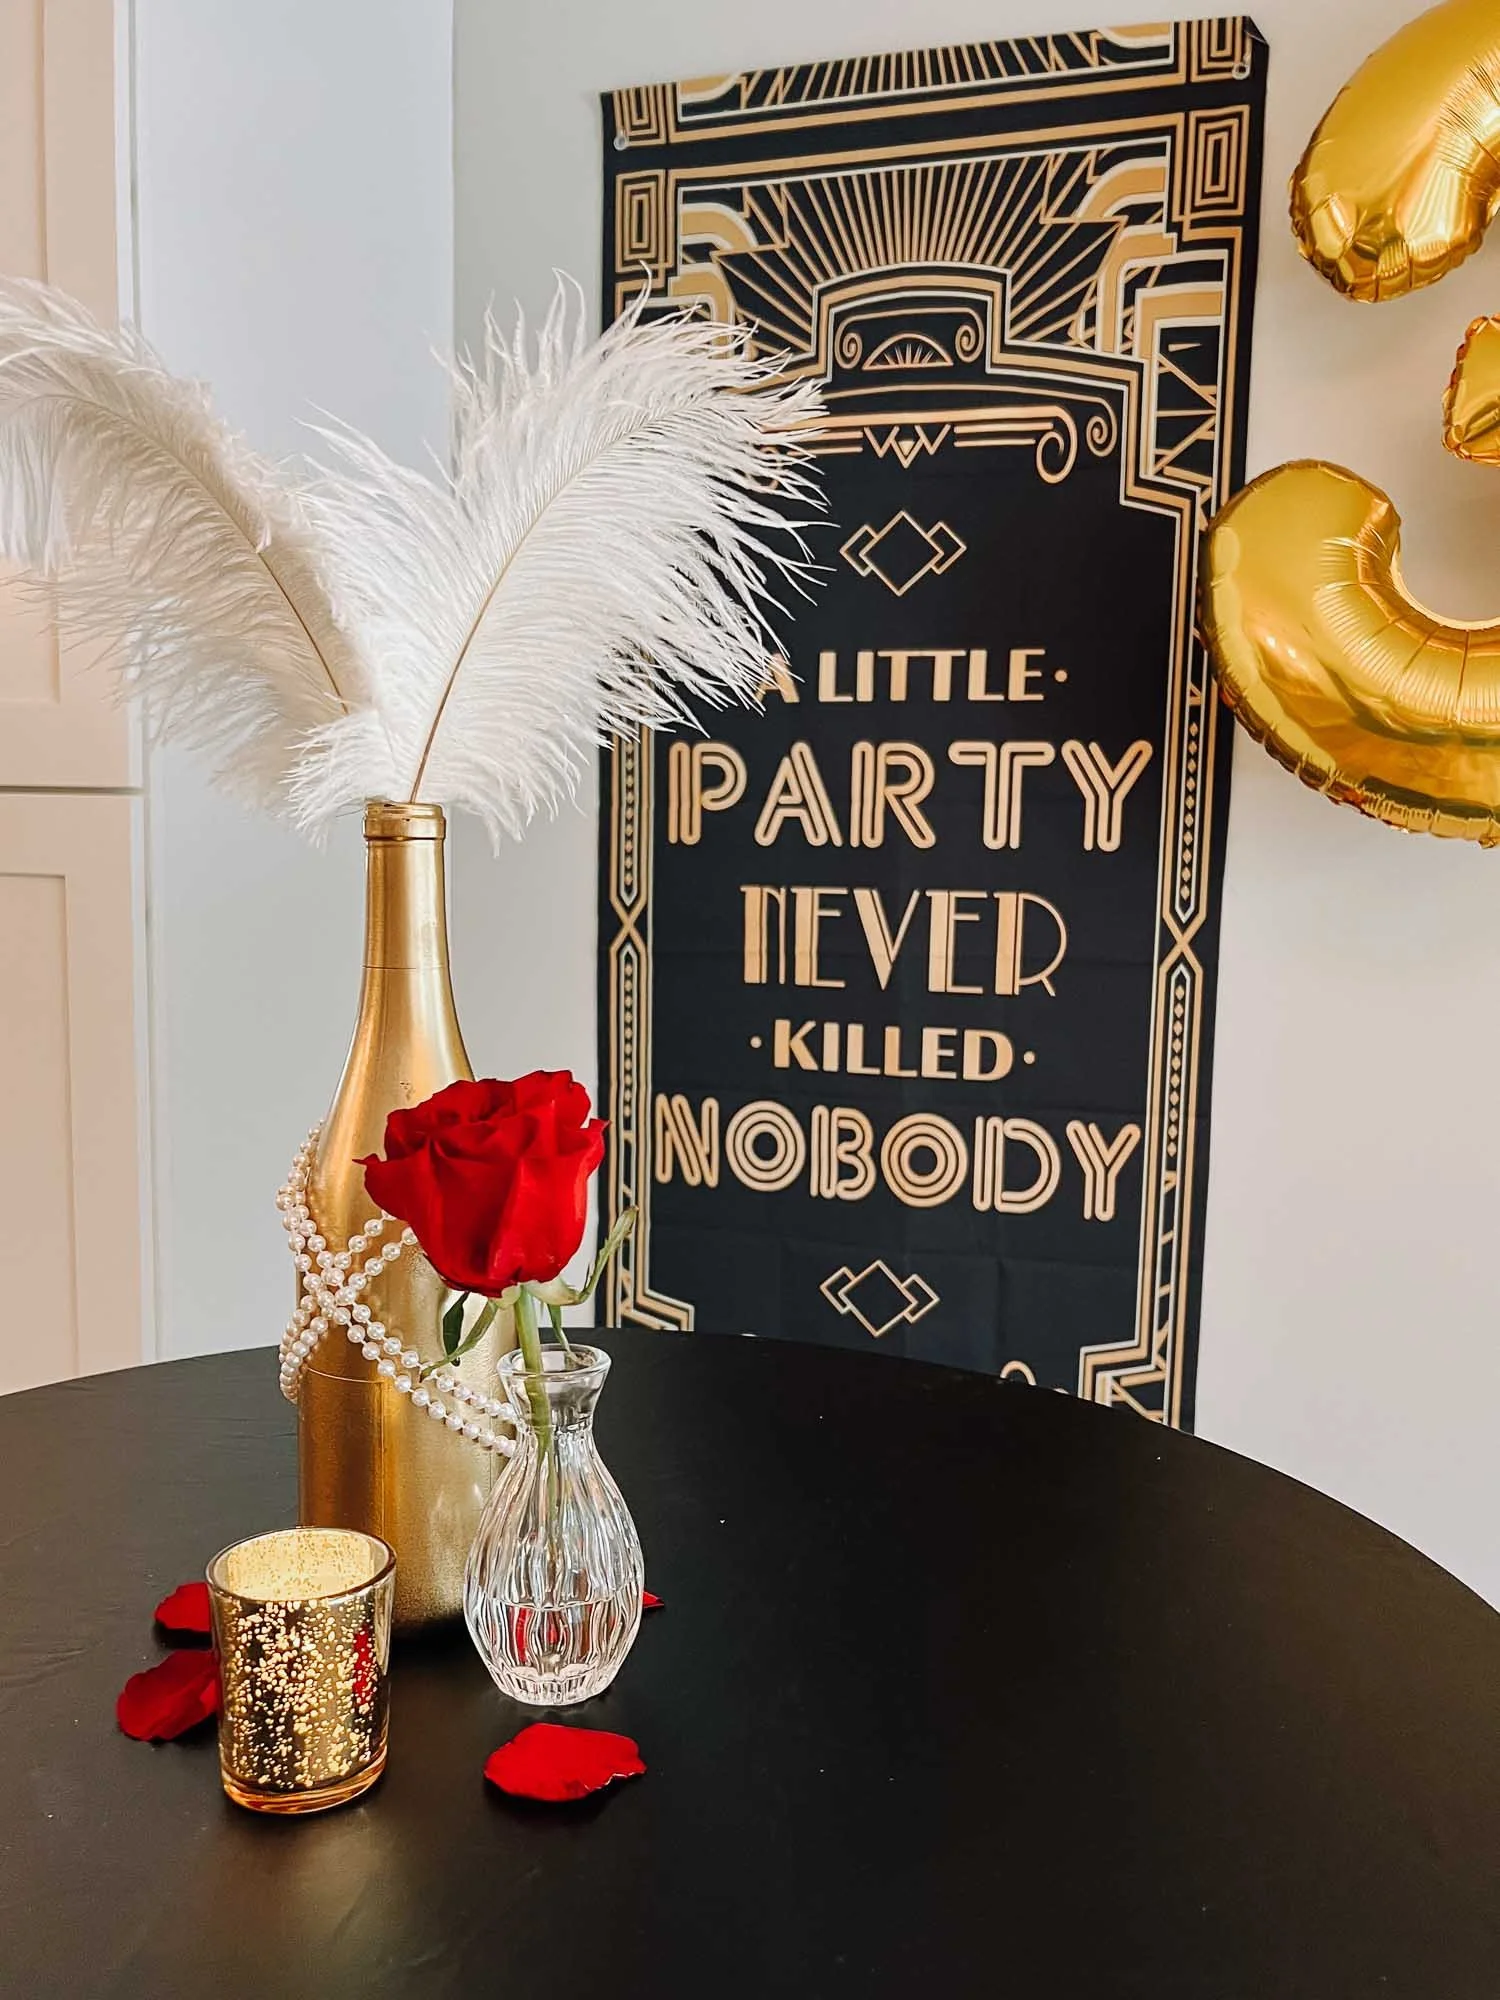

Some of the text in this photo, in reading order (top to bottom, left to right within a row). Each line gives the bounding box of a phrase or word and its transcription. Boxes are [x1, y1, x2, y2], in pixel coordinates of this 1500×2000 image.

[668, 740, 1153, 852] PARTY
[740, 886, 1067, 997] NEVER
[655, 1093, 1141, 1222] NOBODY
